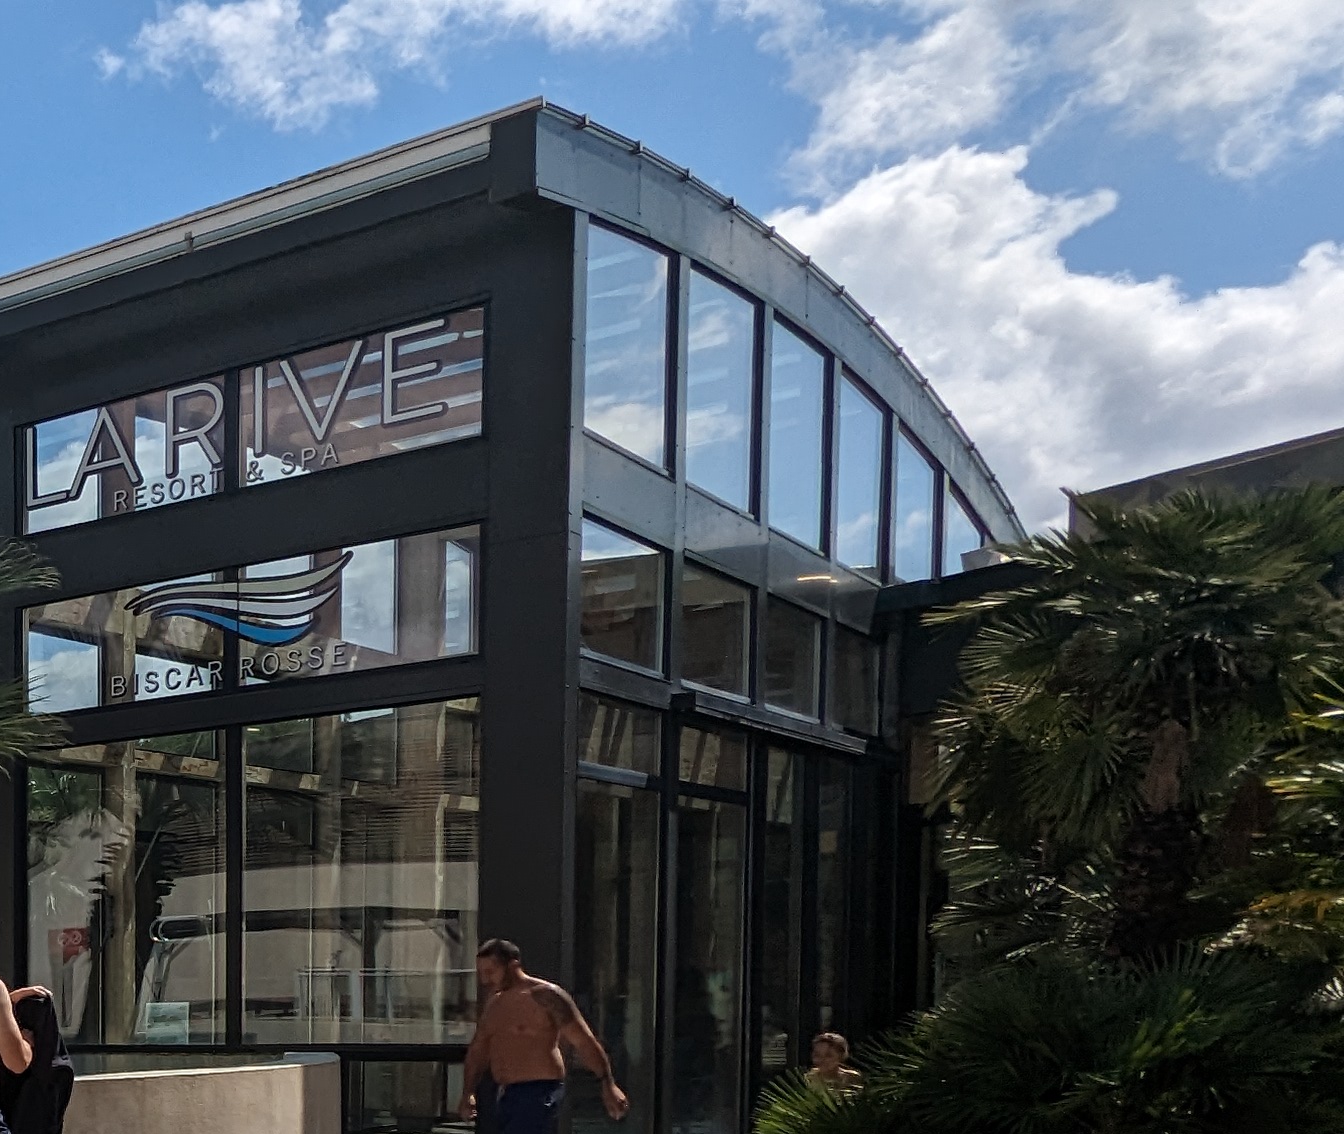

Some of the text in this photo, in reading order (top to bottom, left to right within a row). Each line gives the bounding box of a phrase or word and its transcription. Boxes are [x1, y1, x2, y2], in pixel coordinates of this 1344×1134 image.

[113, 442, 340, 512] RESORT & SPA
